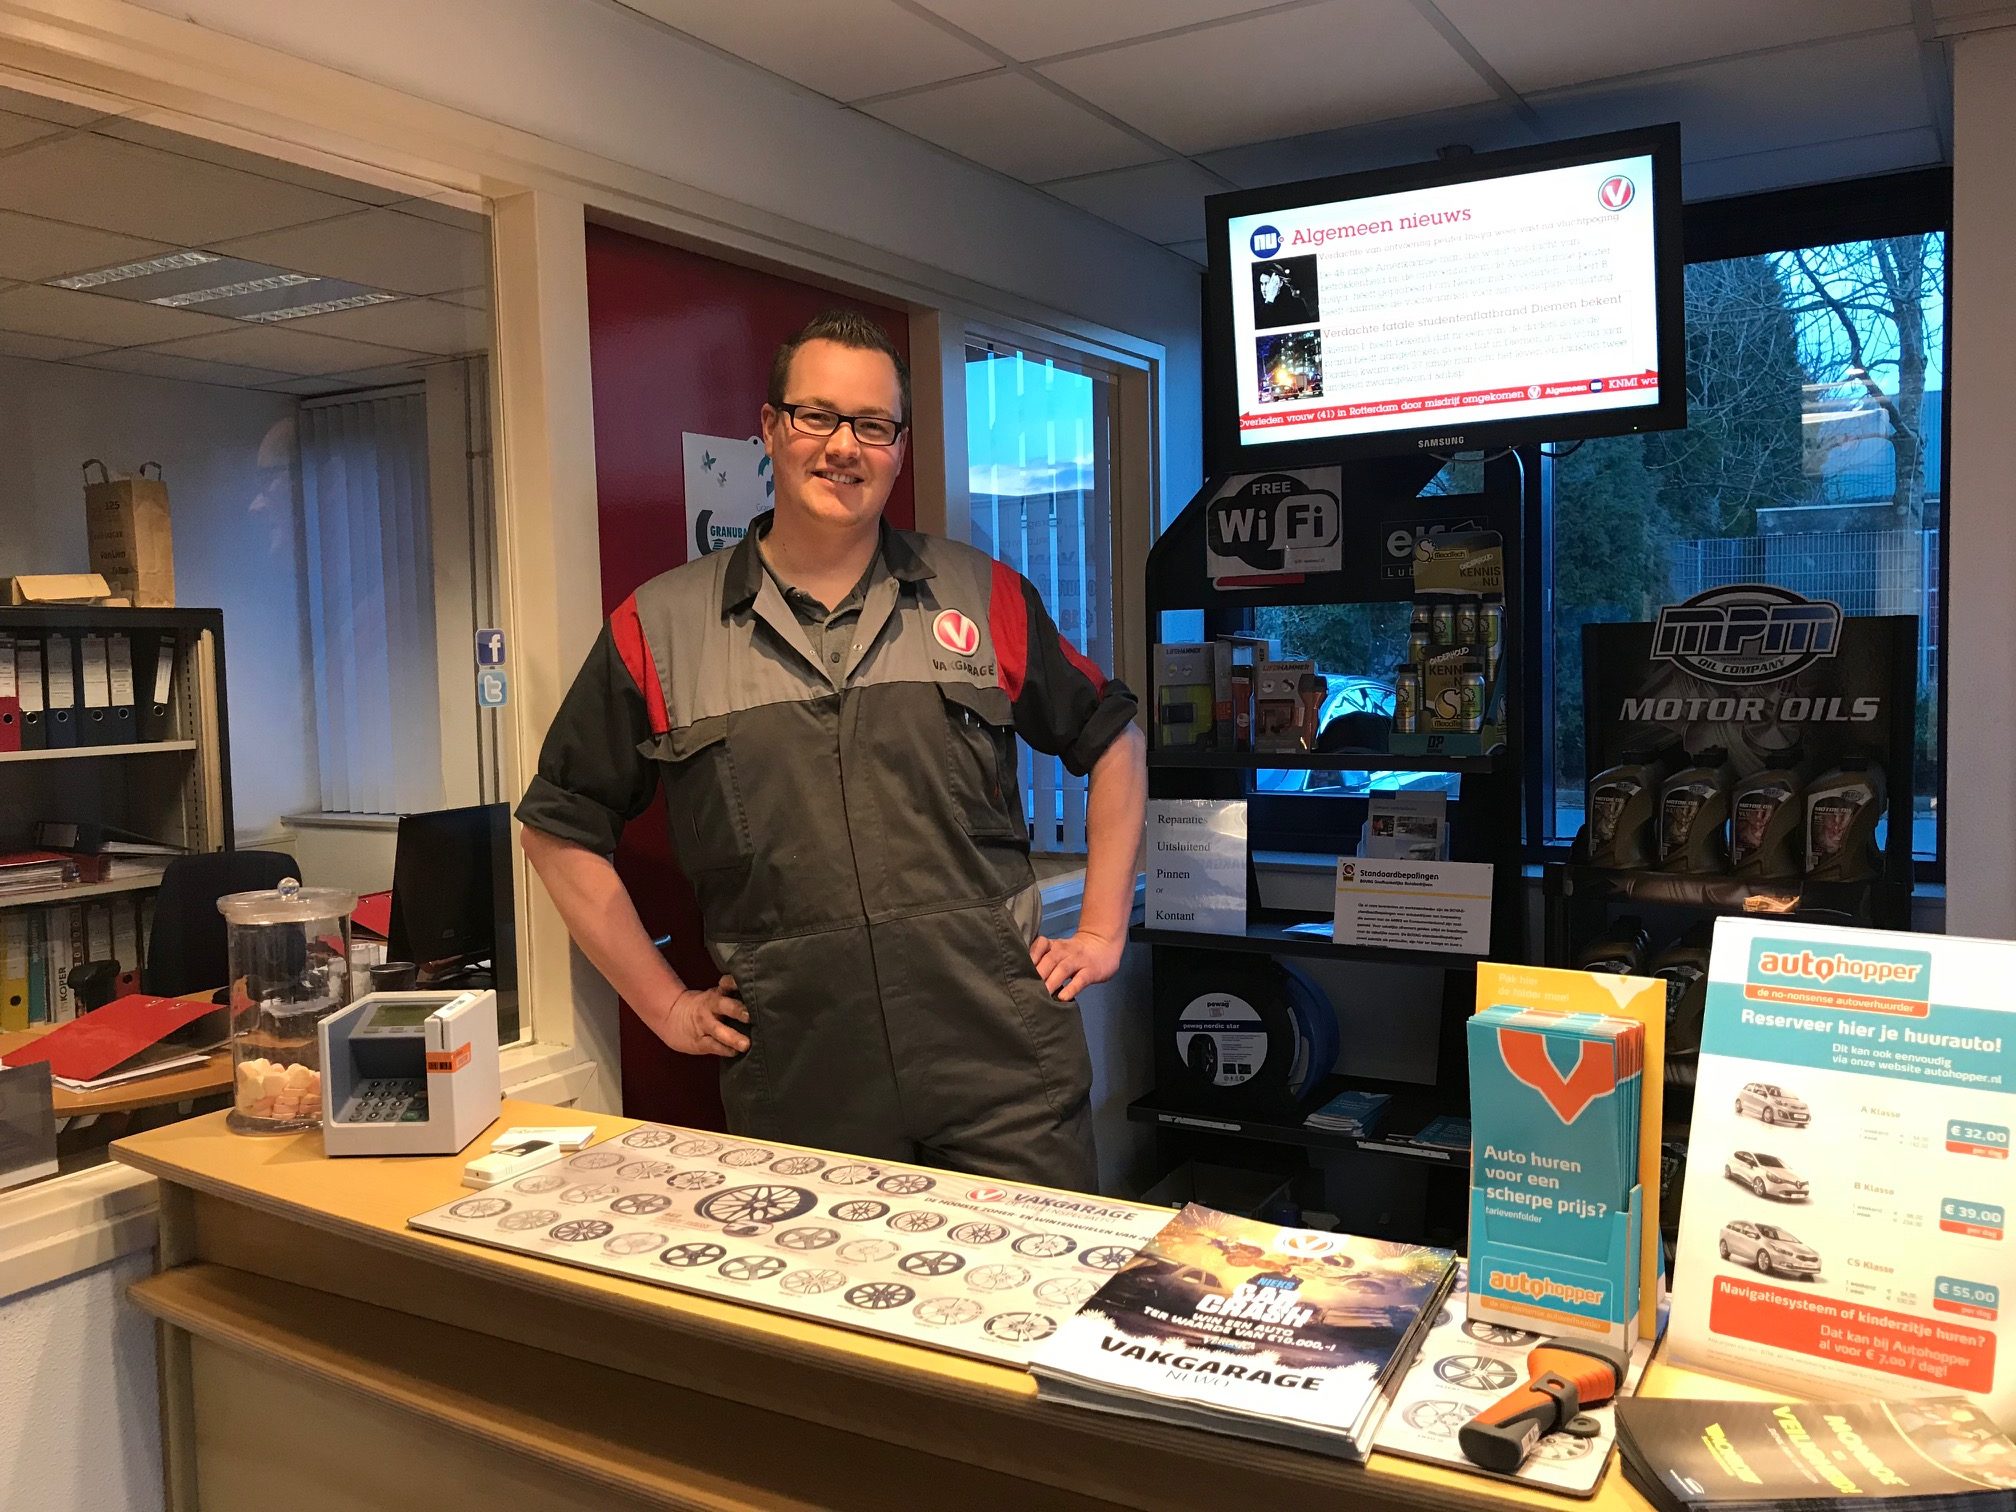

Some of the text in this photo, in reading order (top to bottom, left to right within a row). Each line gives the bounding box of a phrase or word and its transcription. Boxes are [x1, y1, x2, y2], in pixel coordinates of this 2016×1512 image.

[1291, 219, 1392, 247] Algemeen
[1399, 208, 1472, 231] nieuws
[1322, 294, 1622, 339] Verdachte fatale studentenflatbrand Diemen bekent
[1286, 413, 1314, 424] vrouw
[1337, 407, 1347, 417] in
[1349, 400, 1398, 416] Rotterdam
[1401, 398, 1422, 410] door
[1424, 393, 1460, 409] misdrijf
[1462, 389, 1525, 406] omgekomen
[1609, 376, 1638, 390] KNMI
[1418, 435, 1465, 448] SAMSUNG
[1252, 481, 1291, 496] FREE
[1460, 566, 1502, 577] KENNIS
[1483, 577, 1500, 587] NU
[1429, 665, 1462, 676] KENN
[1698, 656, 1787, 674] OIL COMPANY
[1618, 697, 1880, 721] MOTOR OILS
[1157, 813, 1208, 827] Reparaties
[1156, 841, 1212, 852] Uitsluitend
[1156, 869, 1190, 880] Pinnen
[1359, 869, 1440, 882] Standaardbepalingen
[1155, 910, 1195, 921] Kontant
[1759, 951, 1919, 982] autohopper
[1757, 988, 1915, 1013] de no-nonsense autoverhuurder
[1741, 1008, 2002, 1053] Reserveer hier je huurauto!
[1832, 1043, 1952, 1069] Dit kan ook eenvoudig
[1832, 1054, 2002, 1084] via onze website autohopper.nl
[1870, 1107, 1901, 1118] Klasse
[1950, 1125, 1961, 1136] €
[1484, 1144, 1582, 1174] Auto huren
[1485, 1167, 1560, 1190] voor een
[1864, 1183, 1895, 1196] Klasse
[1014, 1192, 1139, 1221] VAKGARAGE
[1486, 1186, 1608, 1219] scherpe prijs?
[1944, 1204, 1955, 1215] €
[1485, 1206, 1543, 1224] tarievenfolder
[1034, 1216, 1113, 1235] WINTERWIELEN
[1115, 1231, 1138, 1240] VAN
[1847, 1258, 1895, 1274] CS Klasse
[1489, 1270, 1605, 1304] autohopper
[1939, 1282, 1950, 1294] €
[1195, 1293, 1314, 1328] CRASH
[1720, 1281, 1986, 1348] Navigatiesysteem of kinderzitje huren?
[1144, 1306, 1169, 1320] TER
[1171, 1314, 1234, 1334] WAARDE
[1235, 1328, 1266, 1340] VAN
[1192, 1312, 1295, 1337] WIN EEN AUTO
[1818, 1338, 1832, 1351] al
[1833, 1343, 1863, 1357] voor
[1865, 1348, 1875, 1361] €
[1820, 1324, 1971, 1369] Dat kan bij Autohopper
[1100, 1336, 1325, 1393] VAKGARAGE
